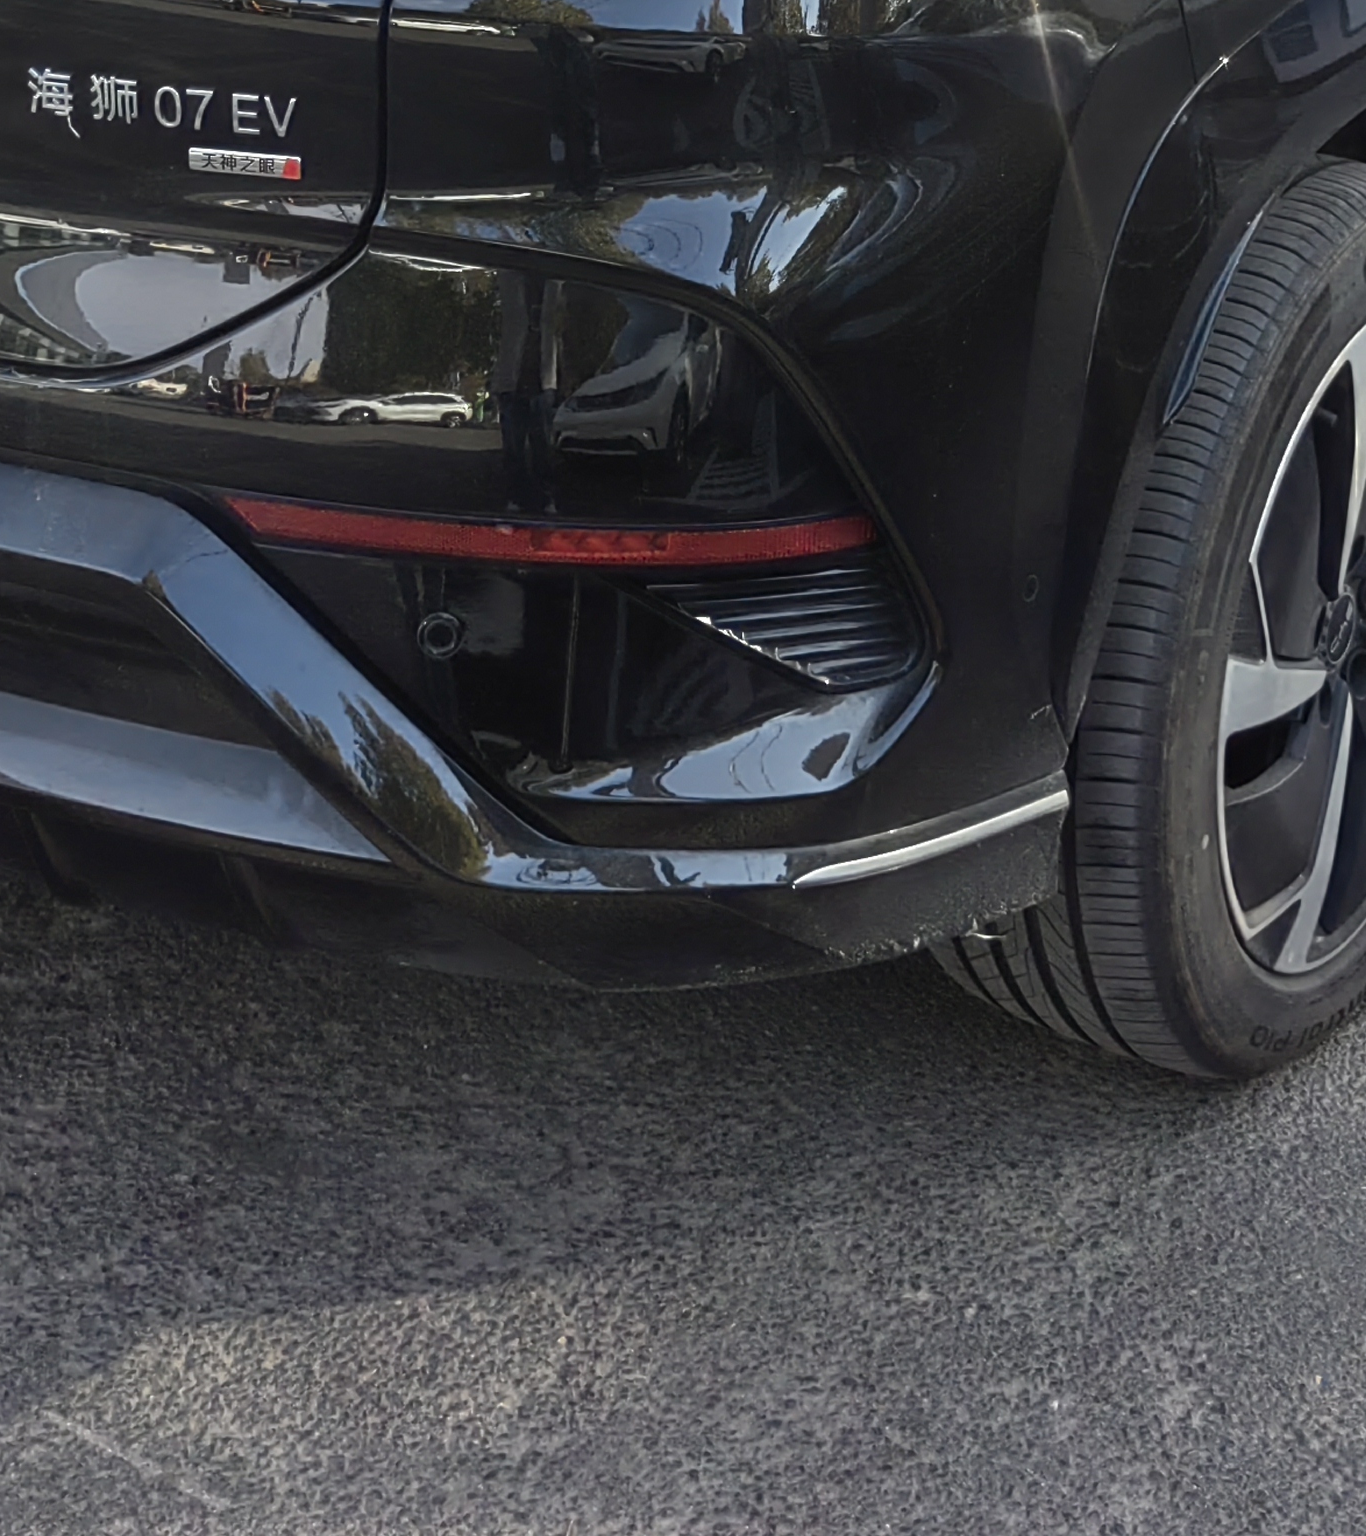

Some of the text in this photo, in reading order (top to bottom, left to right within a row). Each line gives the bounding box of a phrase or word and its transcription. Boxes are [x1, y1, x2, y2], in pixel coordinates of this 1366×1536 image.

[27, 66, 298, 138] 海狮 07 EV
[201, 152, 276, 175] 天神之眼
